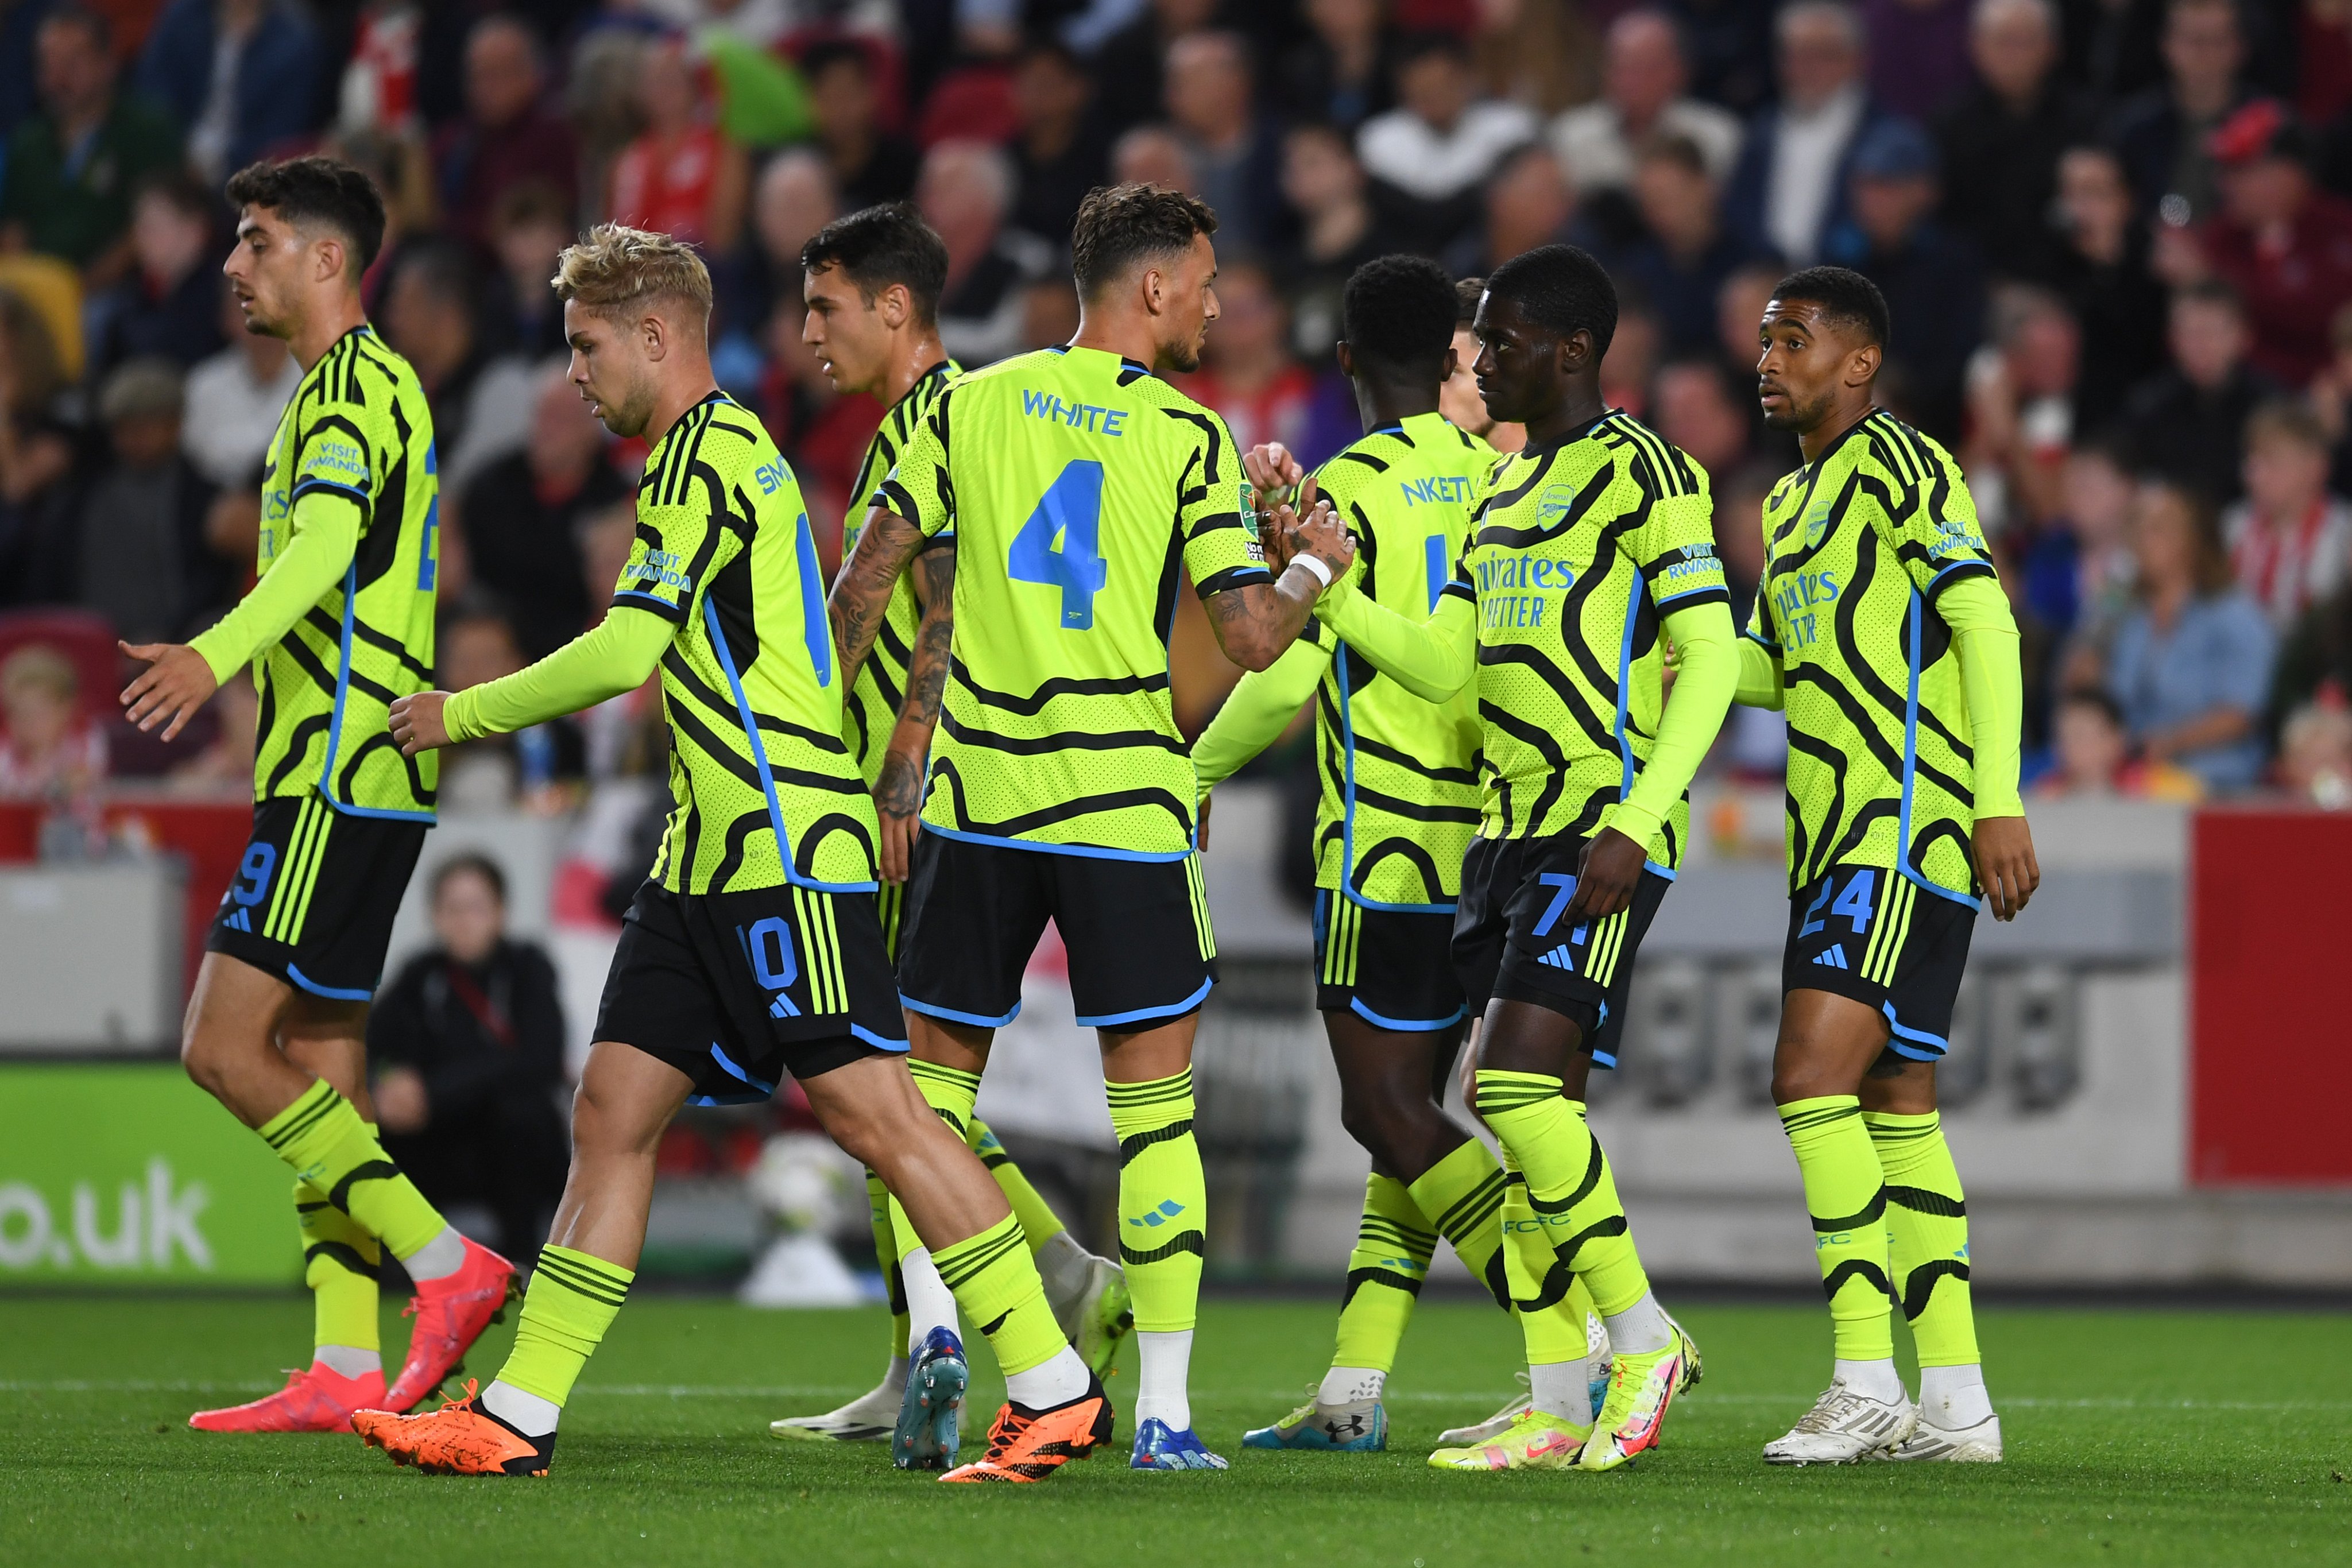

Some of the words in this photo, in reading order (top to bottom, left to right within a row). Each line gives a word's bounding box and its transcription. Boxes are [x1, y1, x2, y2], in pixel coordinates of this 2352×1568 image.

[1023, 389, 1129, 437] WHITE
[319, 442, 359, 459] VISIT
[643, 548, 680, 569] VISIT
[1007, 458, 1108, 631] 4
[626, 564, 691, 593] RWANDA
[220, 841, 277, 907] 9
[1797, 869, 1875, 939] 24
[0, 1159, 215, 1269] o.uk
[1502, 1219, 1539, 1235] FC
[1816, 1233, 1851, 1250] FC
